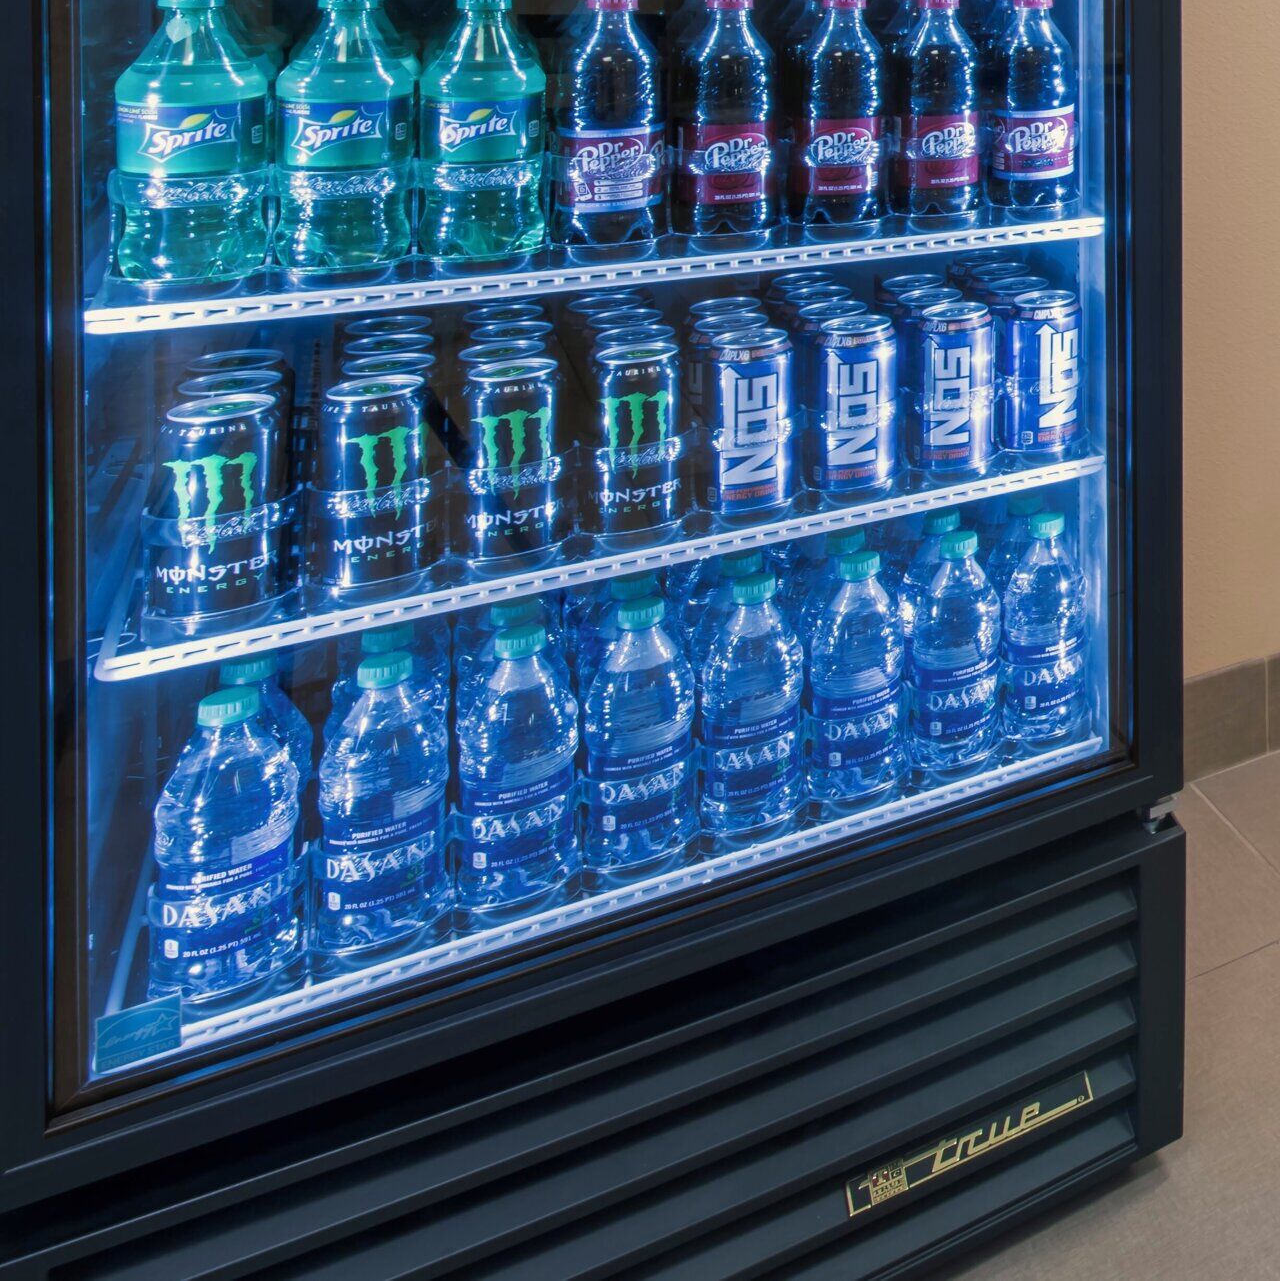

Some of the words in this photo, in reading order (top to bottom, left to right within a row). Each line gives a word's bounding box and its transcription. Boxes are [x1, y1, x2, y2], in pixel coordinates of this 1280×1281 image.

[147, 119, 227, 156] Sprite
[303, 117, 373, 152] Sprite
[444, 115, 514, 148] Sprite
[833, 132, 855, 146] Dr
[940, 125, 962, 139] Dr
[1030, 121, 1053, 134] Dr
[598, 142, 624, 156] Dr
[707, 143, 766, 169] Pepper
[729, 137, 753, 151] Dr
[812, 137, 869, 163] Pepper
[576, 145, 641, 173] Pepper
[609, 366, 661, 378] TAURINE
[1037, 324, 1079, 429] NOS
[923, 337, 971, 446] NOS
[824, 352, 879, 467] NOS
[178, 423, 248, 437] TAURINE
[721, 367, 778, 486] NOS
[588, 478, 682, 504] MONSTER
[156, 550, 277, 585] MONSTER
[166, 573, 265, 594] ENERGY
[627, 753, 655, 765] PURIFIED
[656, 745, 673, 757] WATER
[498, 789, 528, 800] PURIFIED
[529, 781, 549, 794] WATER
[352, 827, 384, 839] PURIFIED
[385, 821, 407, 833] WATER
[192, 869, 227, 885] PURIFIED
[227, 863, 253, 877] WATER
[932, 1101, 1070, 1172] true
